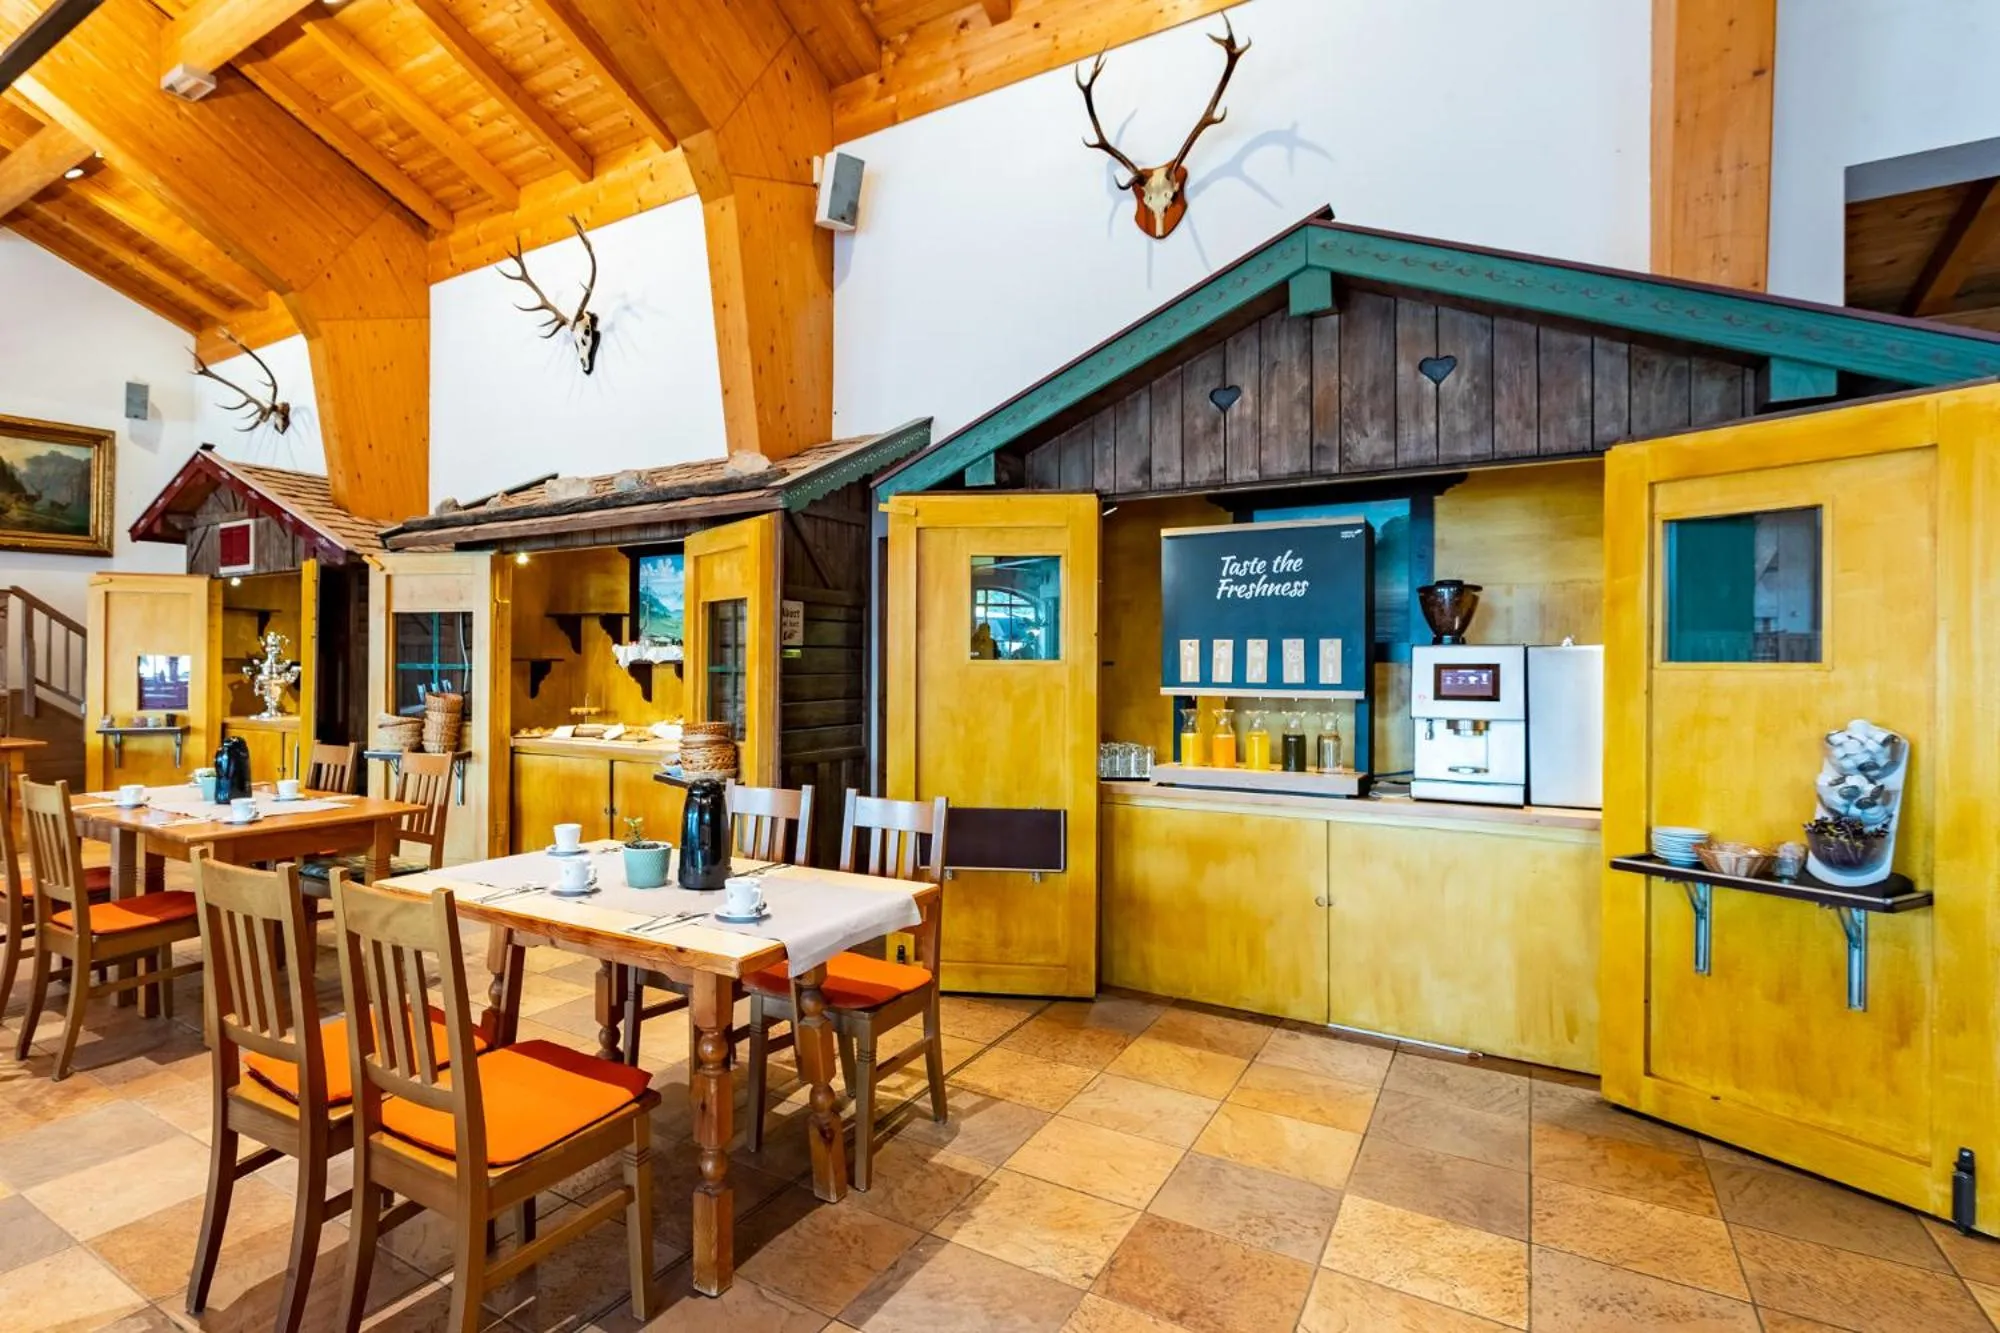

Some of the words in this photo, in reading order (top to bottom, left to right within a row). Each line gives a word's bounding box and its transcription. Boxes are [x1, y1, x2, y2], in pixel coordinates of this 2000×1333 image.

[1221, 555, 1267, 576] Taste
[1272, 549, 1304, 574] the
[1216, 574, 1309, 600] Freshness
